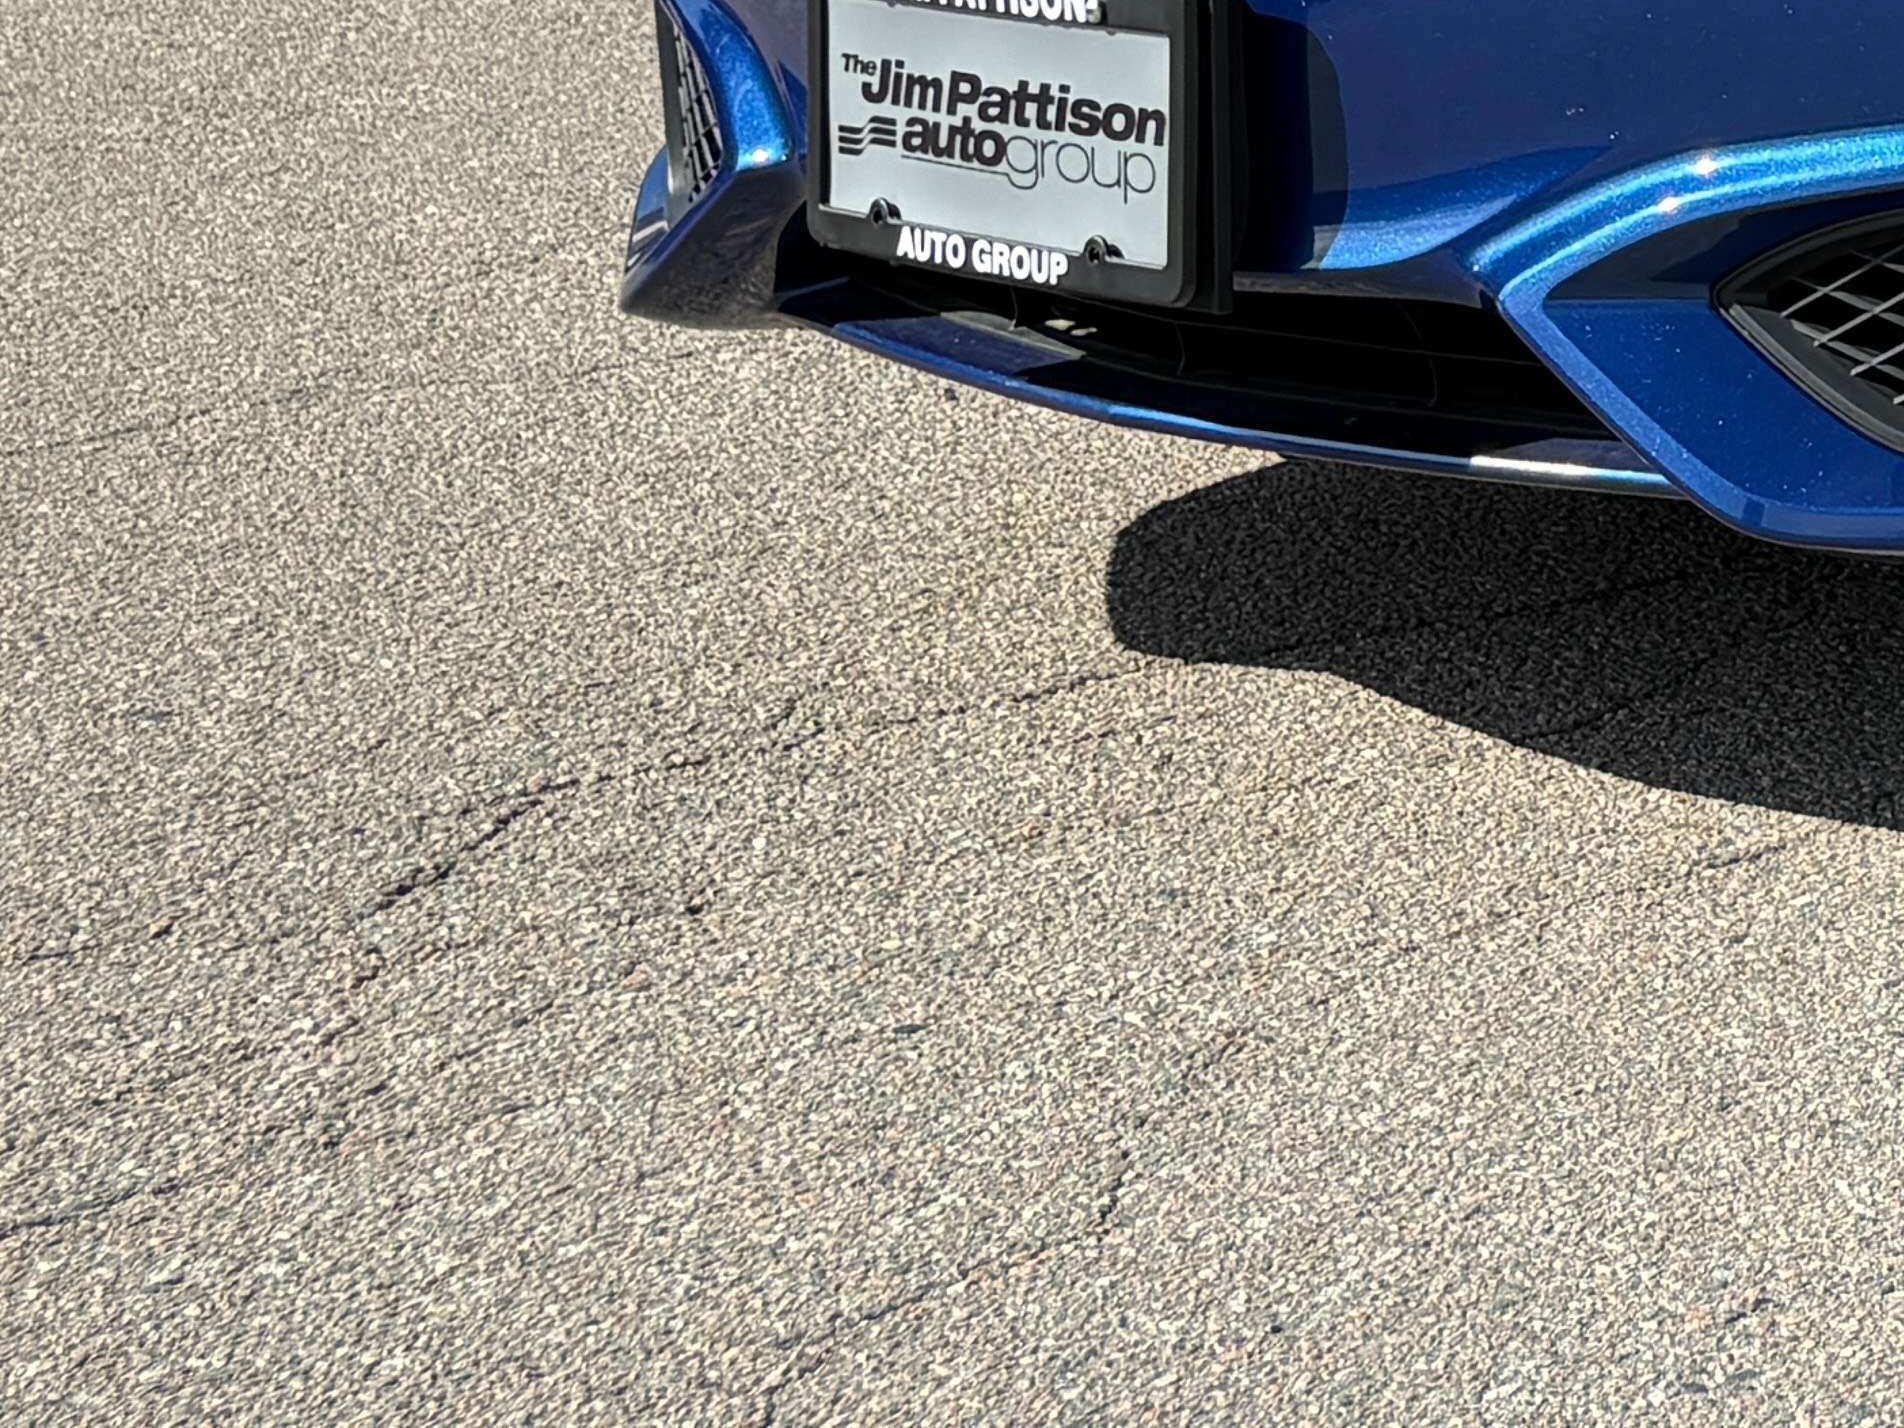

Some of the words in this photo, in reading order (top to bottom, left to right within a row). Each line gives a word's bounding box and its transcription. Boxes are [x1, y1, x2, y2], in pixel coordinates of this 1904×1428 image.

[841, 53, 878, 78] The
[896, 225, 967, 270] AUTO
[972, 237, 1069, 286] GROUP
